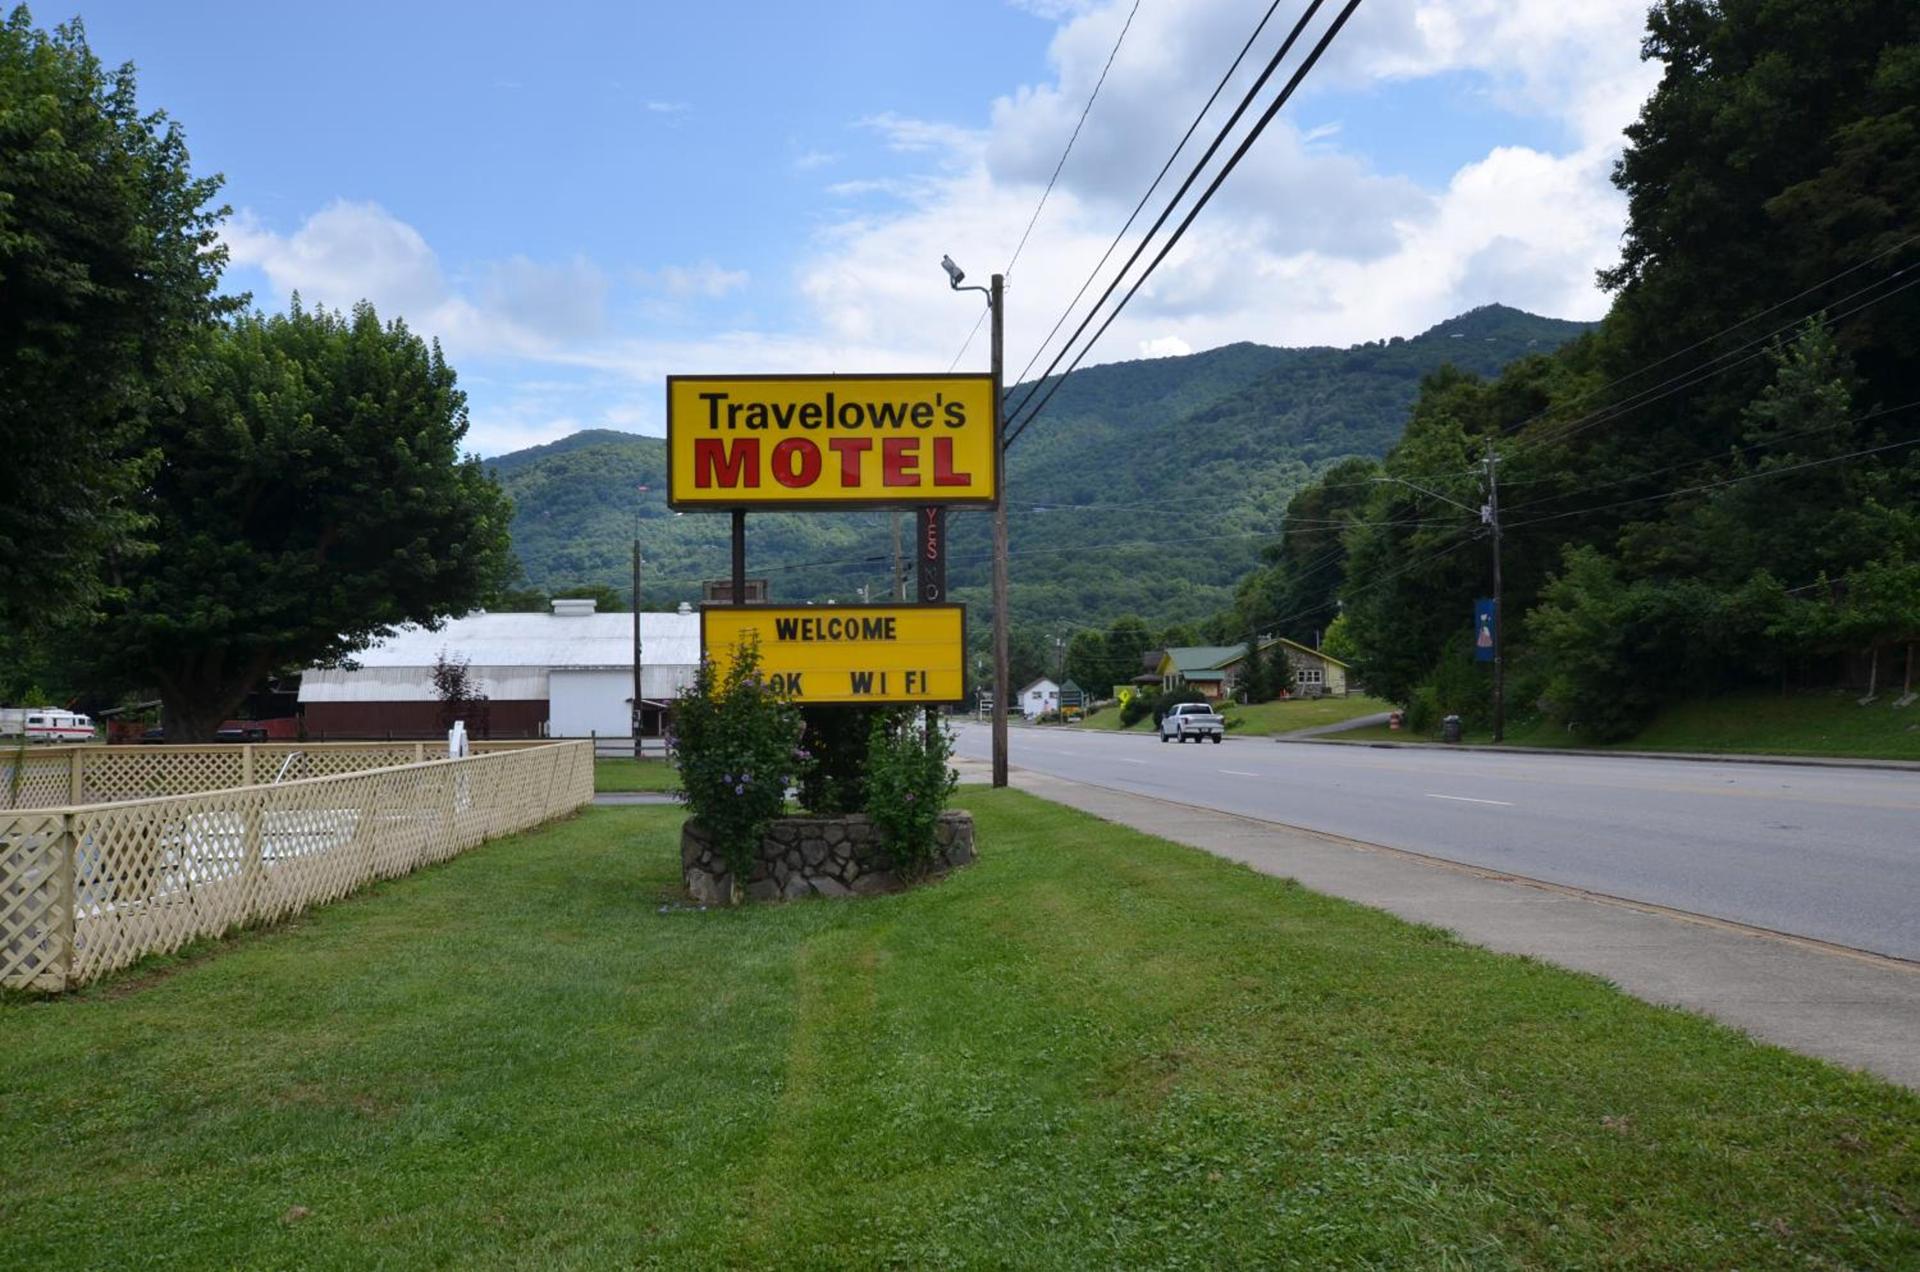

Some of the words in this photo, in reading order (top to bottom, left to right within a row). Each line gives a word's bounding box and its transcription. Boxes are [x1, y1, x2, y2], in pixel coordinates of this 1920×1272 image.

[699, 392, 966, 430] Travelowe's
[694, 437, 971, 488] MOTEL
[926, 507, 937, 559] YES
[775, 617, 897, 641] WELCOME
